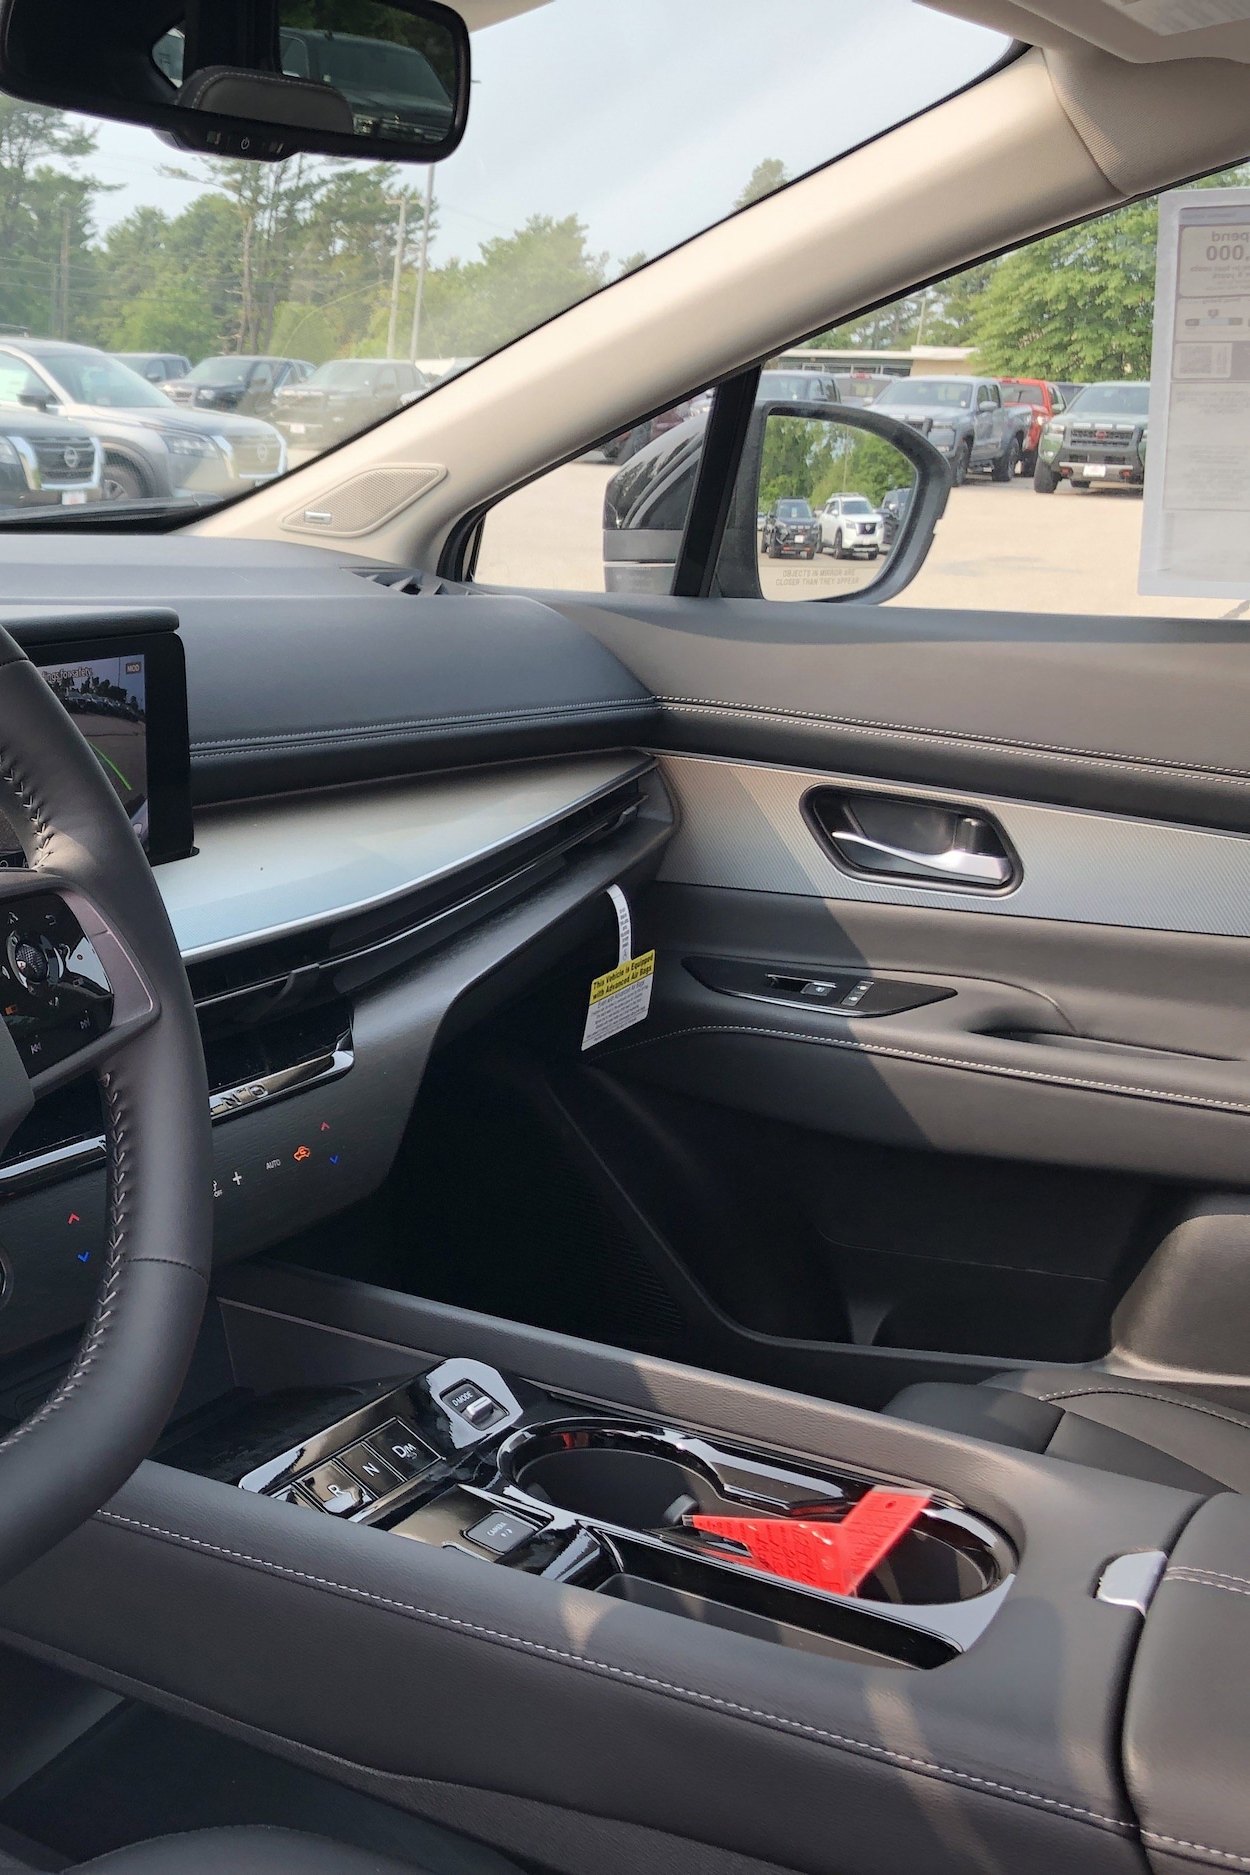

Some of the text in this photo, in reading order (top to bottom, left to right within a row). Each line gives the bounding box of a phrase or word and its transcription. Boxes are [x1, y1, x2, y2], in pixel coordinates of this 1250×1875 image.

[265, 1159, 282, 1170] AUTO
[361, 1461, 380, 1477] N
[327, 1484, 345, 1498] R
